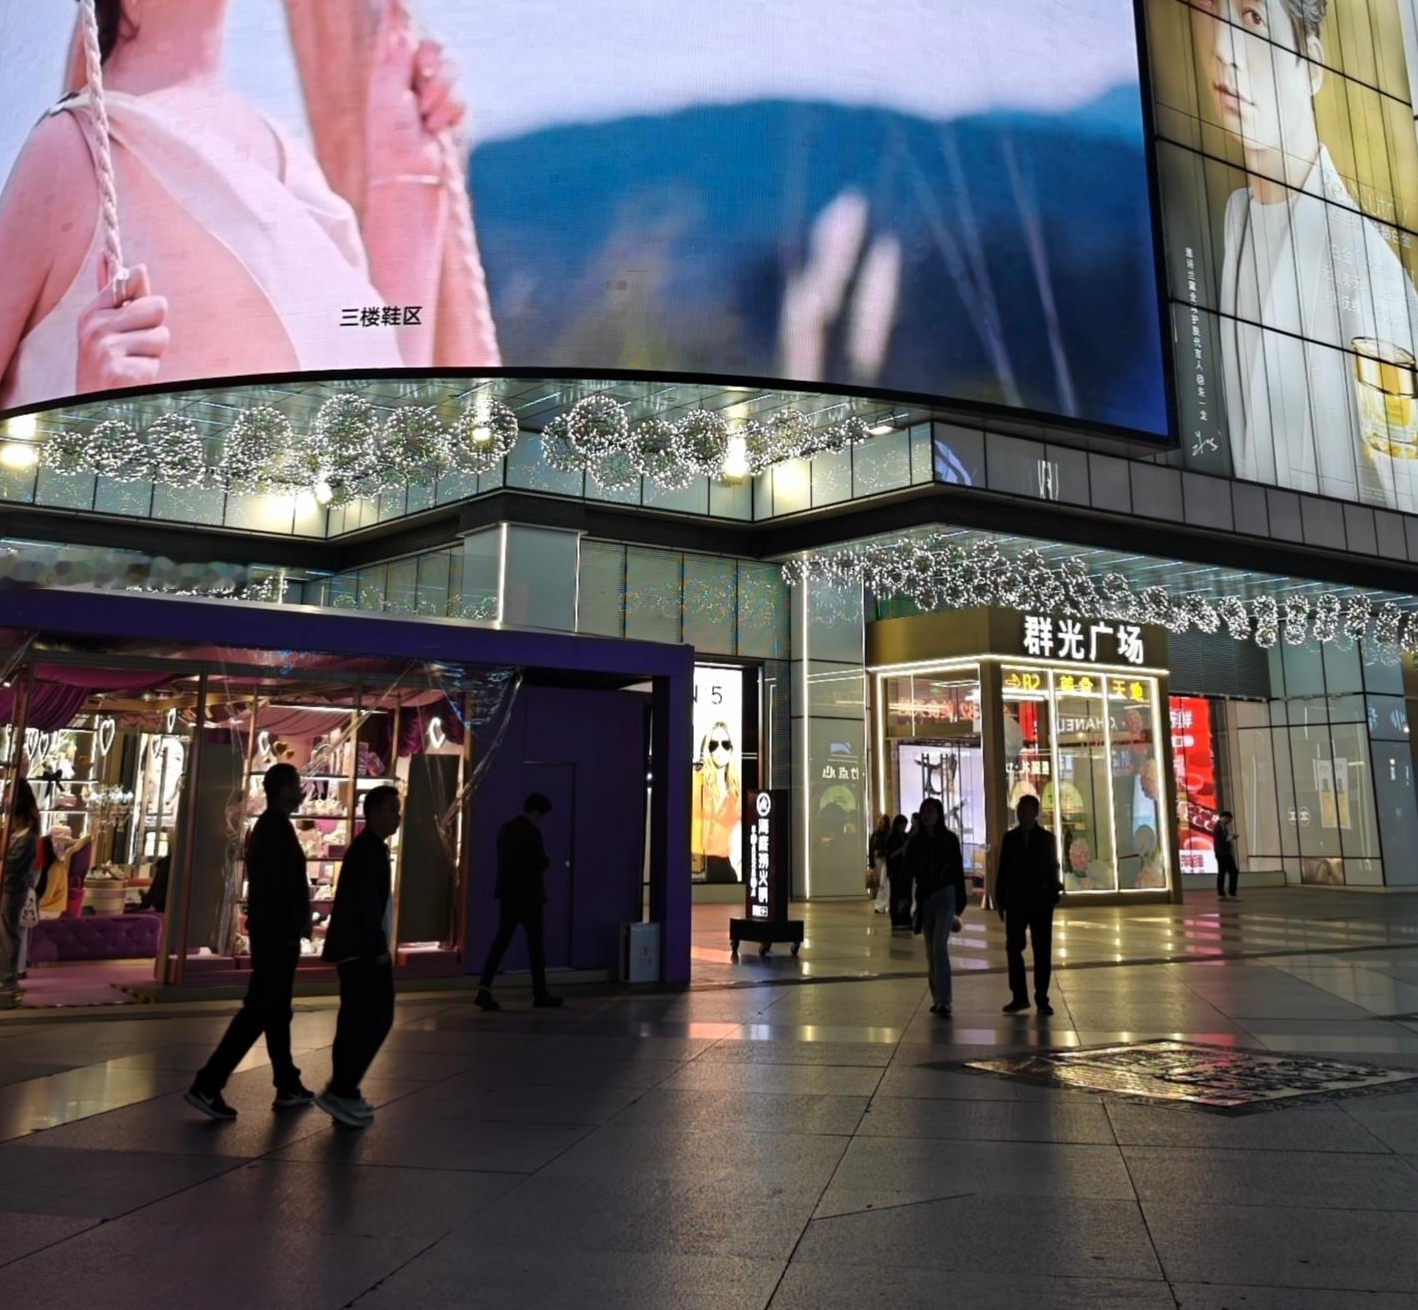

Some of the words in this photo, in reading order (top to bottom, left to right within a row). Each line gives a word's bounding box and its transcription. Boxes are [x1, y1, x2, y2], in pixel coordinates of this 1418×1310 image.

[339, 305, 423, 328] 三楼鞋区
[1023, 615, 1145, 664] 群光广场
